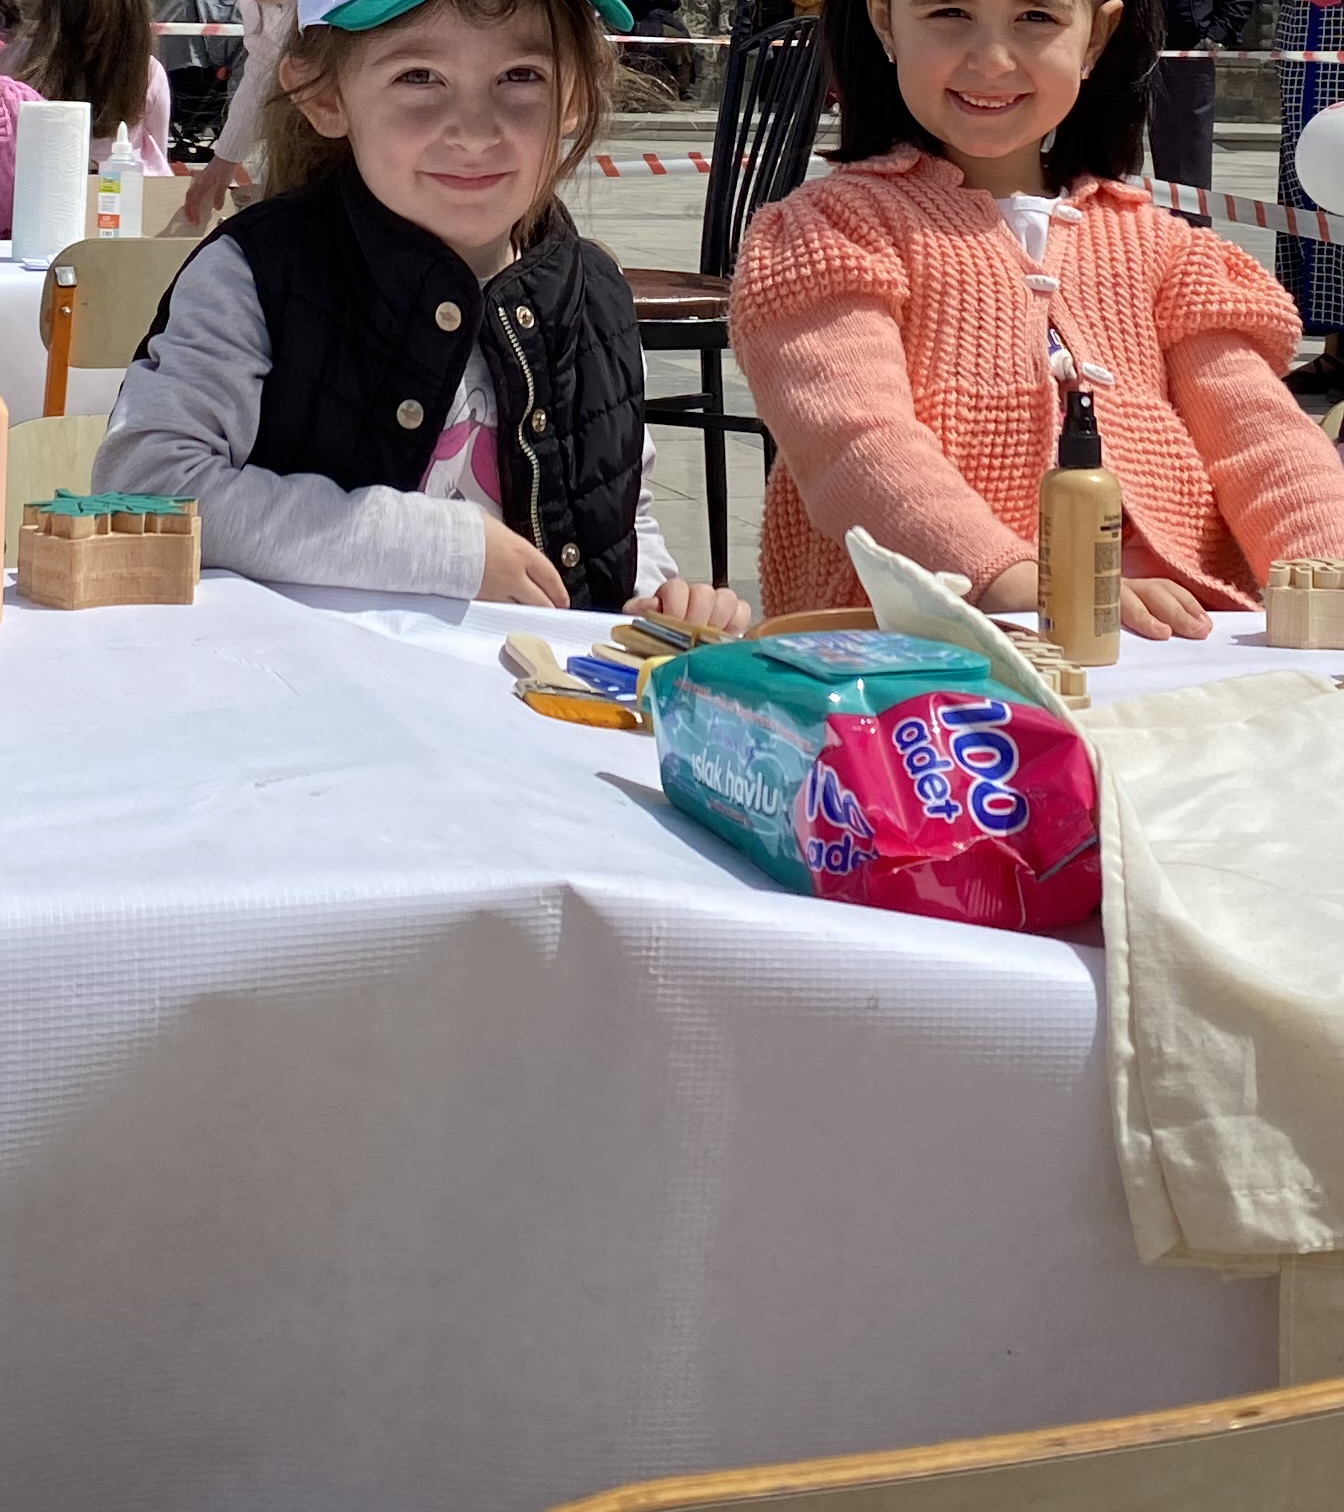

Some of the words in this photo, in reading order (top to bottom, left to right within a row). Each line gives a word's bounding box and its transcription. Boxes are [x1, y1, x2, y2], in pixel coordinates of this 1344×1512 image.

[725, 759, 779, 816] havlu
[892, 716, 964, 825] adet
[937, 698, 1030, 837] 100
